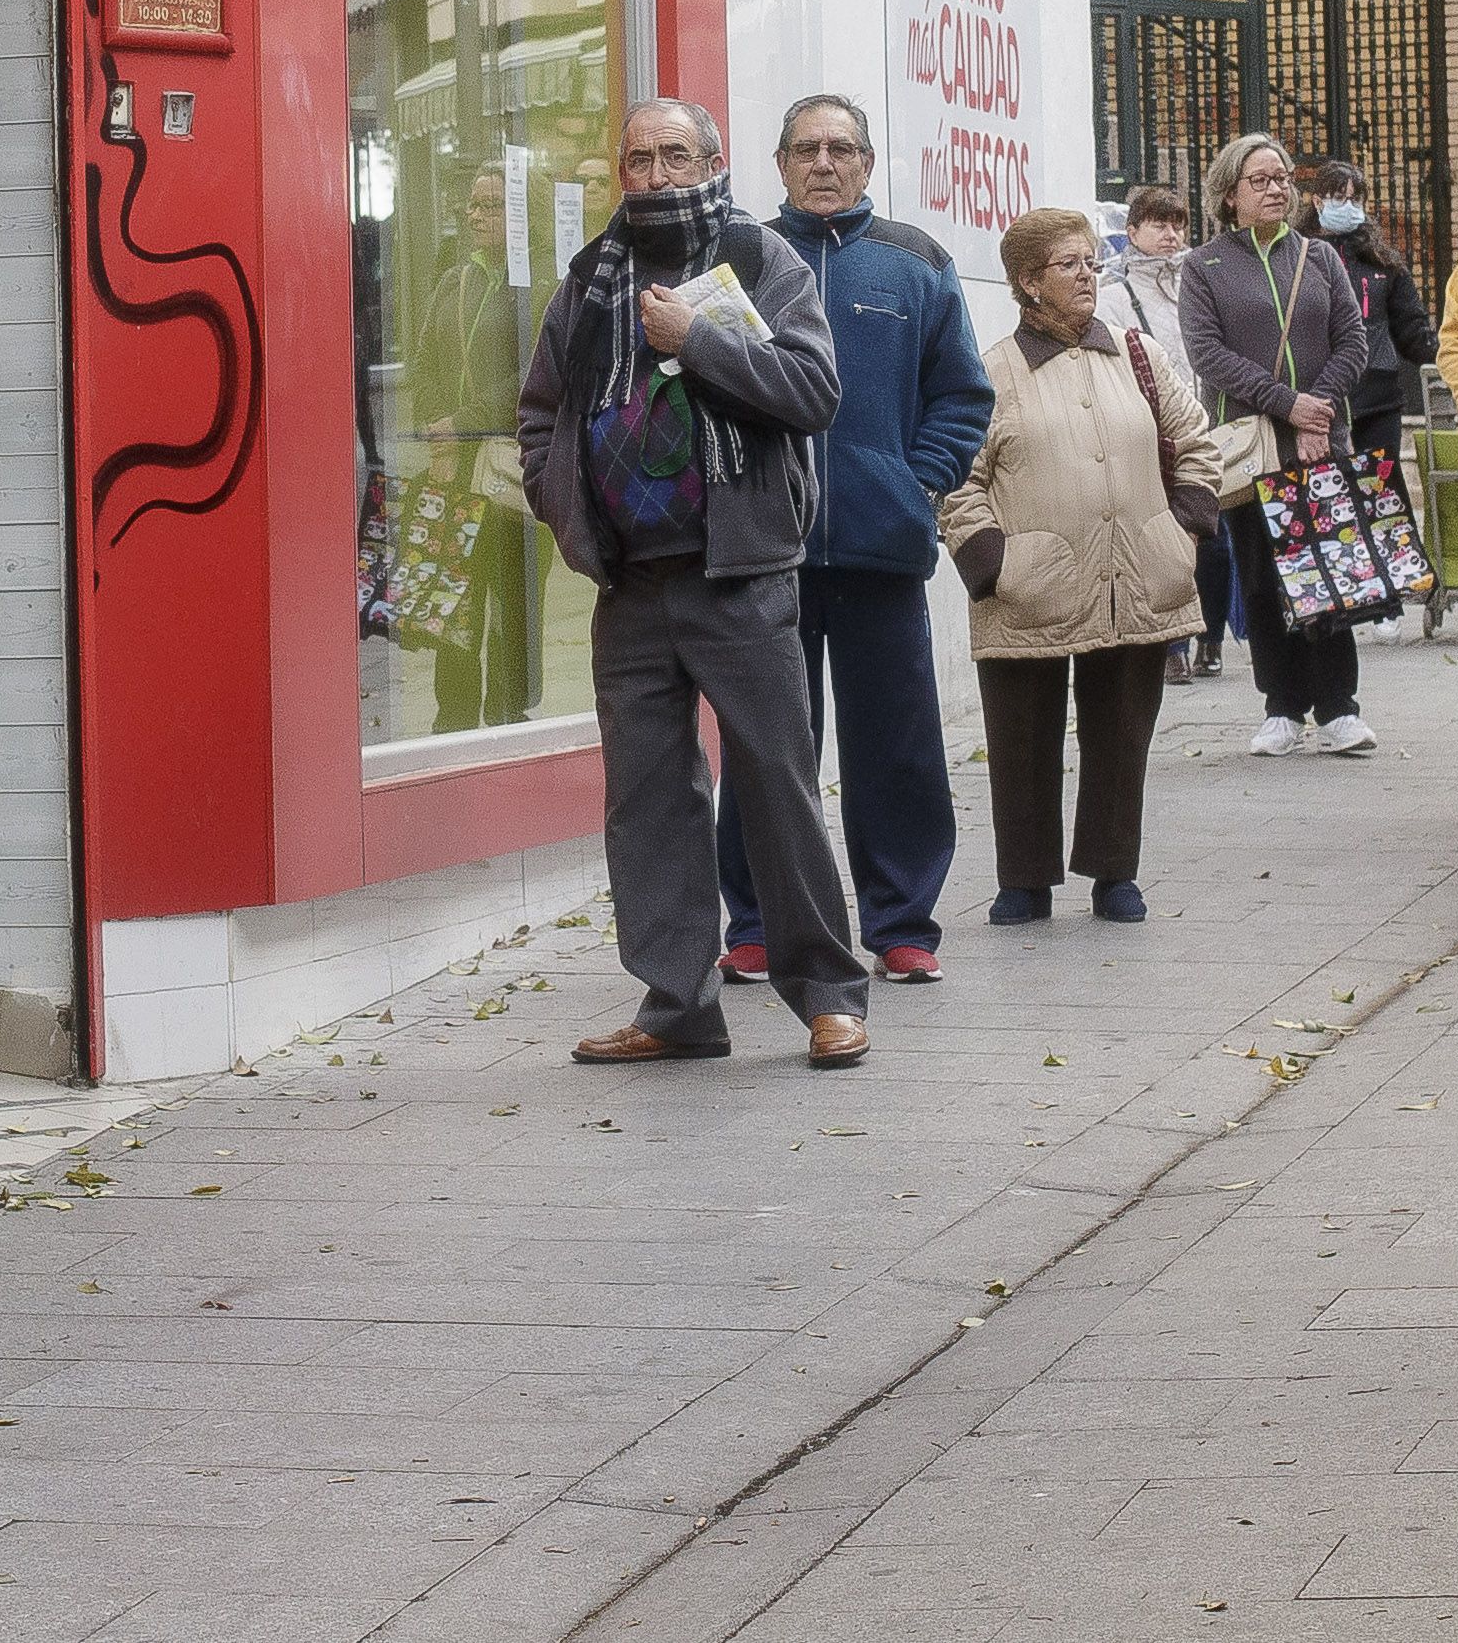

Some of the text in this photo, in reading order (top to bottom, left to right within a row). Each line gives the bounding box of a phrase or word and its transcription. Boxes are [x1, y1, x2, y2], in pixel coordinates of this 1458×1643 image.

[138, 5, 169, 21] 10:00
[181, 8, 213, 25] 14:30
[940, 3, 1021, 120] CALIDAD
[920, 118, 1032, 233] más FRESCOS
